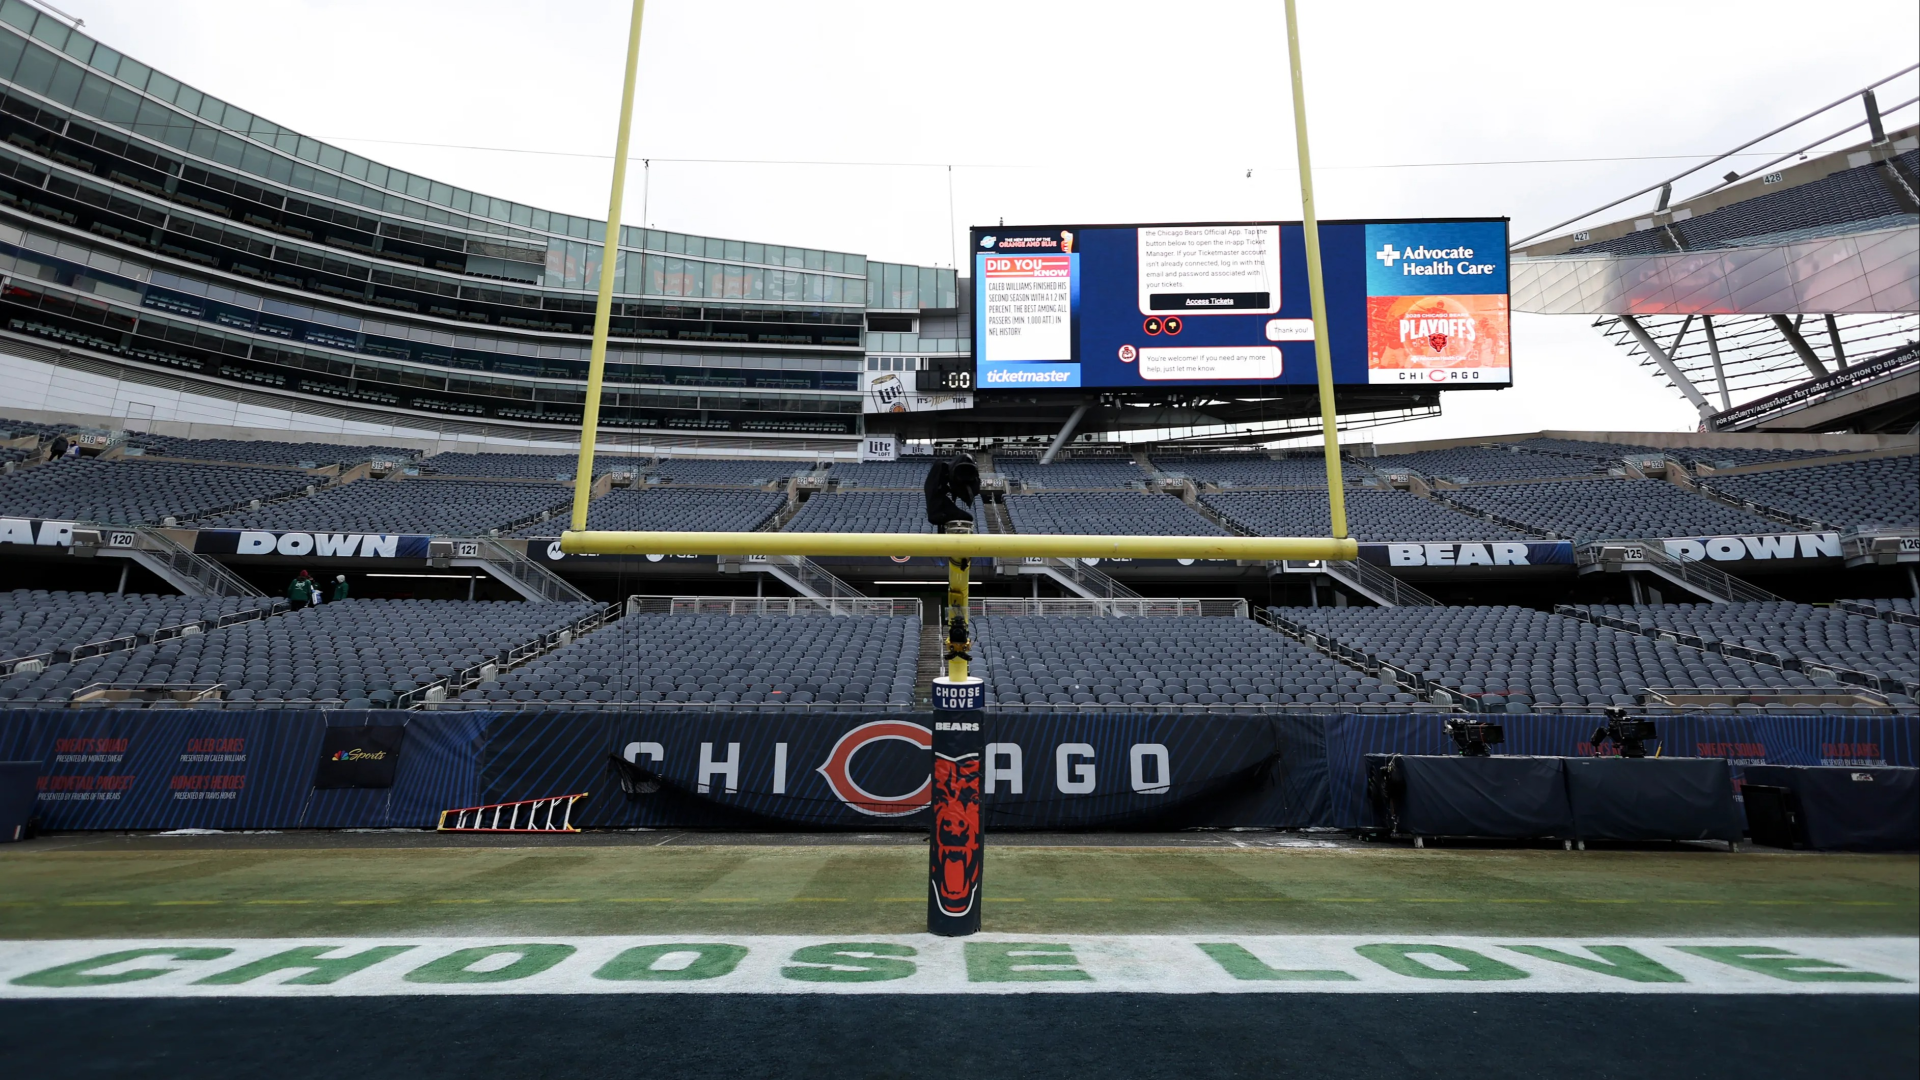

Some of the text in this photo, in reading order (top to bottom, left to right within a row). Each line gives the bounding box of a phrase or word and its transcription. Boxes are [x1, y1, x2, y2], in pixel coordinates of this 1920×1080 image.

[1764, 174, 1782, 183] 428
[1574, 232, 1588, 241] 427
[1403, 246, 1474, 260] Advocate
[987, 259, 1042, 270] DID YOU
[1403, 262, 1494, 275] Health Care
[1006, 282, 1032, 290] WILLIAMS
[1033, 282, 1057, 290] FINISHED
[1058, 282, 1066, 290] HIS
[988, 294, 1009, 302] SECOND
[1010, 293, 1029, 302] SEASON
[1031, 293, 1044, 301] WITH
[1046, 293, 1049, 301] A
[1059, 293, 1067, 301] INT
[1014, 305, 1023, 313] THE
[1024, 305, 1036, 313] BEST
[988, 316, 1011, 324] PASSERS
[988, 328, 998, 336] NFL
[1400, 318, 1476, 342] PLAYOFFS
[987, 369, 1070, 383] ticketmaster
[1399, 370, 1479, 382] CHICAGO
[878, 384, 902, 404] Lite
[1728, 394, 1792, 421] SECURITY/ASSISTANCE
[1793, 388, 1809, 399] TEXT
[1811, 383, 1829, 393] ISSUE
[1836, 367, 1871, 384] LOCATION
[1872, 363, 1882, 372] TO
[81, 435, 94, 444] 318
[869, 441, 891, 454] Lite
[112, 534, 132, 545] 120
[236, 531, 400, 557] DOWN
[1901, 539, 1919, 549] 126
[460, 545, 477, 555] 121
[1625, 549, 1642, 559] 125
[1662, 533, 1844, 562] DOWN
[1388, 543, 1531, 566] BEAR
[936, 687, 980, 698] CHOOSE
[942, 698, 973, 708] LOVE
[935, 722, 979, 731] BEARS
[55, 738, 128, 752] SWEAT'S SQUAD
[187, 738, 244, 752] CALEB CARES
[1696, 743, 1765, 756] SWEAT'S SQUAD
[1822, 743, 1879, 756] CALEB CARES
[349, 748, 386, 762] Sports
[50, 776, 135, 790] DOVETAIL PROJECT
[171, 775, 245, 789] HOMER'S HEROES
[8, 943, 1911, 985] CHOOSE LOVE
